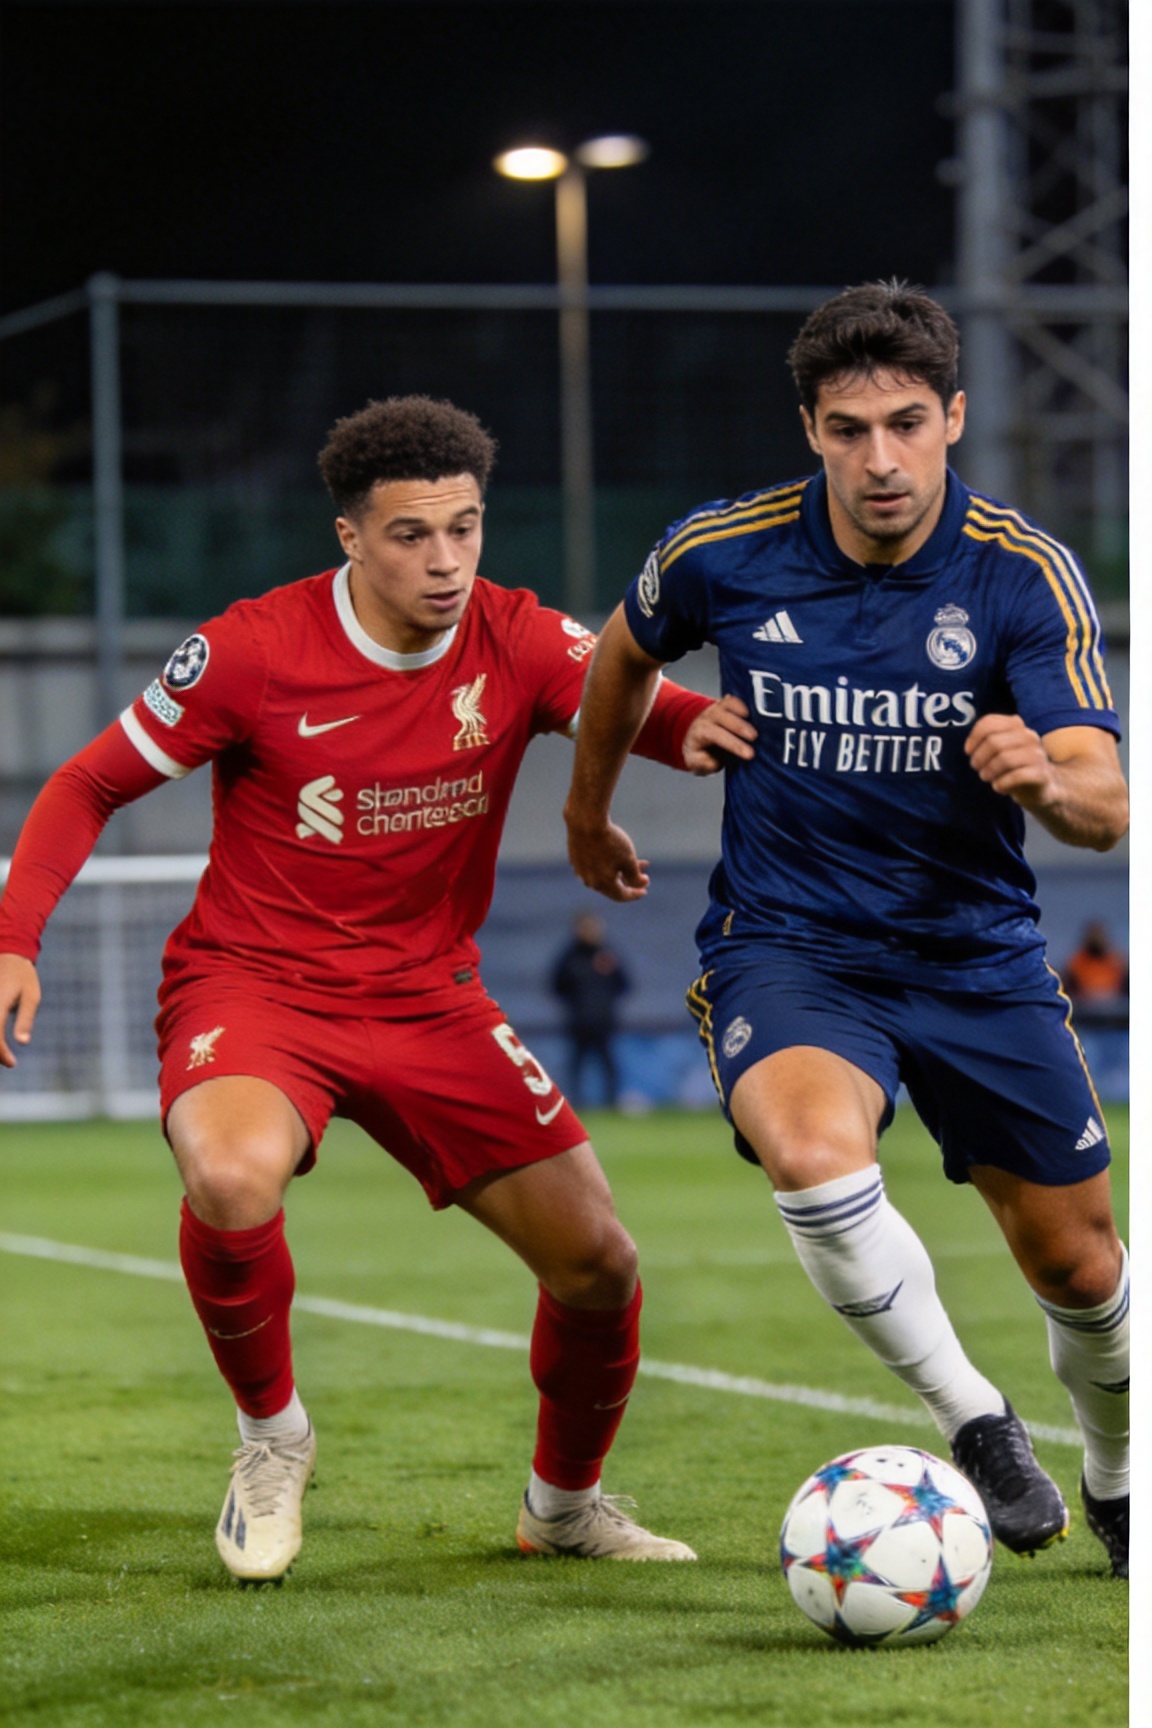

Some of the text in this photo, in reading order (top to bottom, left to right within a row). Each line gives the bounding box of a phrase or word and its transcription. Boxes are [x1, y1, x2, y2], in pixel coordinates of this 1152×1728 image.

[749, 669, 978, 729] Emirates
[782, 727, 944, 774] FLY BETTER
[491, 1022, 552, 1096] 5
